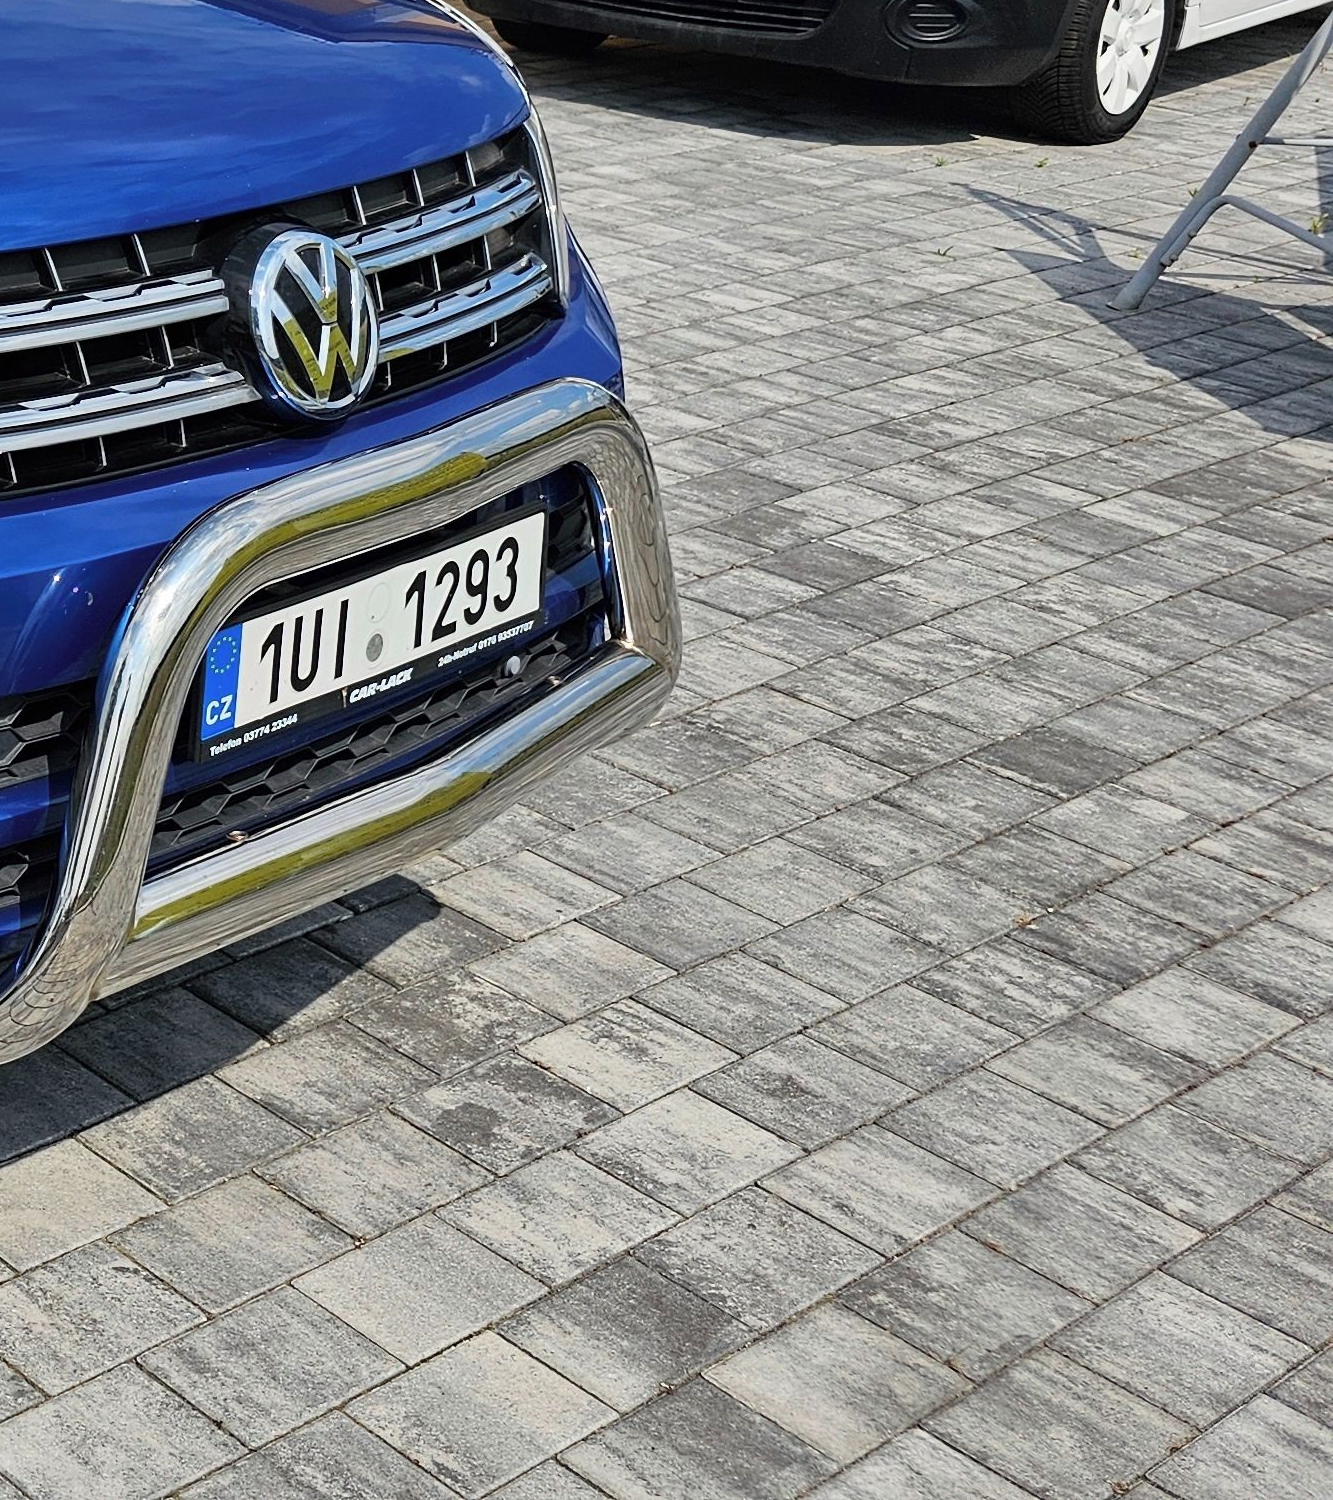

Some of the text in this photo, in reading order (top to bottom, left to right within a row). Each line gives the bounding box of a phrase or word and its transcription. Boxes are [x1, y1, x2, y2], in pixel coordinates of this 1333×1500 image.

[251, 232, 378, 415] VW
[260, 536, 520, 703] 1UI 1293
[349, 667, 414, 704] CAR-LACK
[205, 695, 233, 726] CZ
[209, 736, 242, 757] Telefon
[243, 723, 271, 744] 03774
